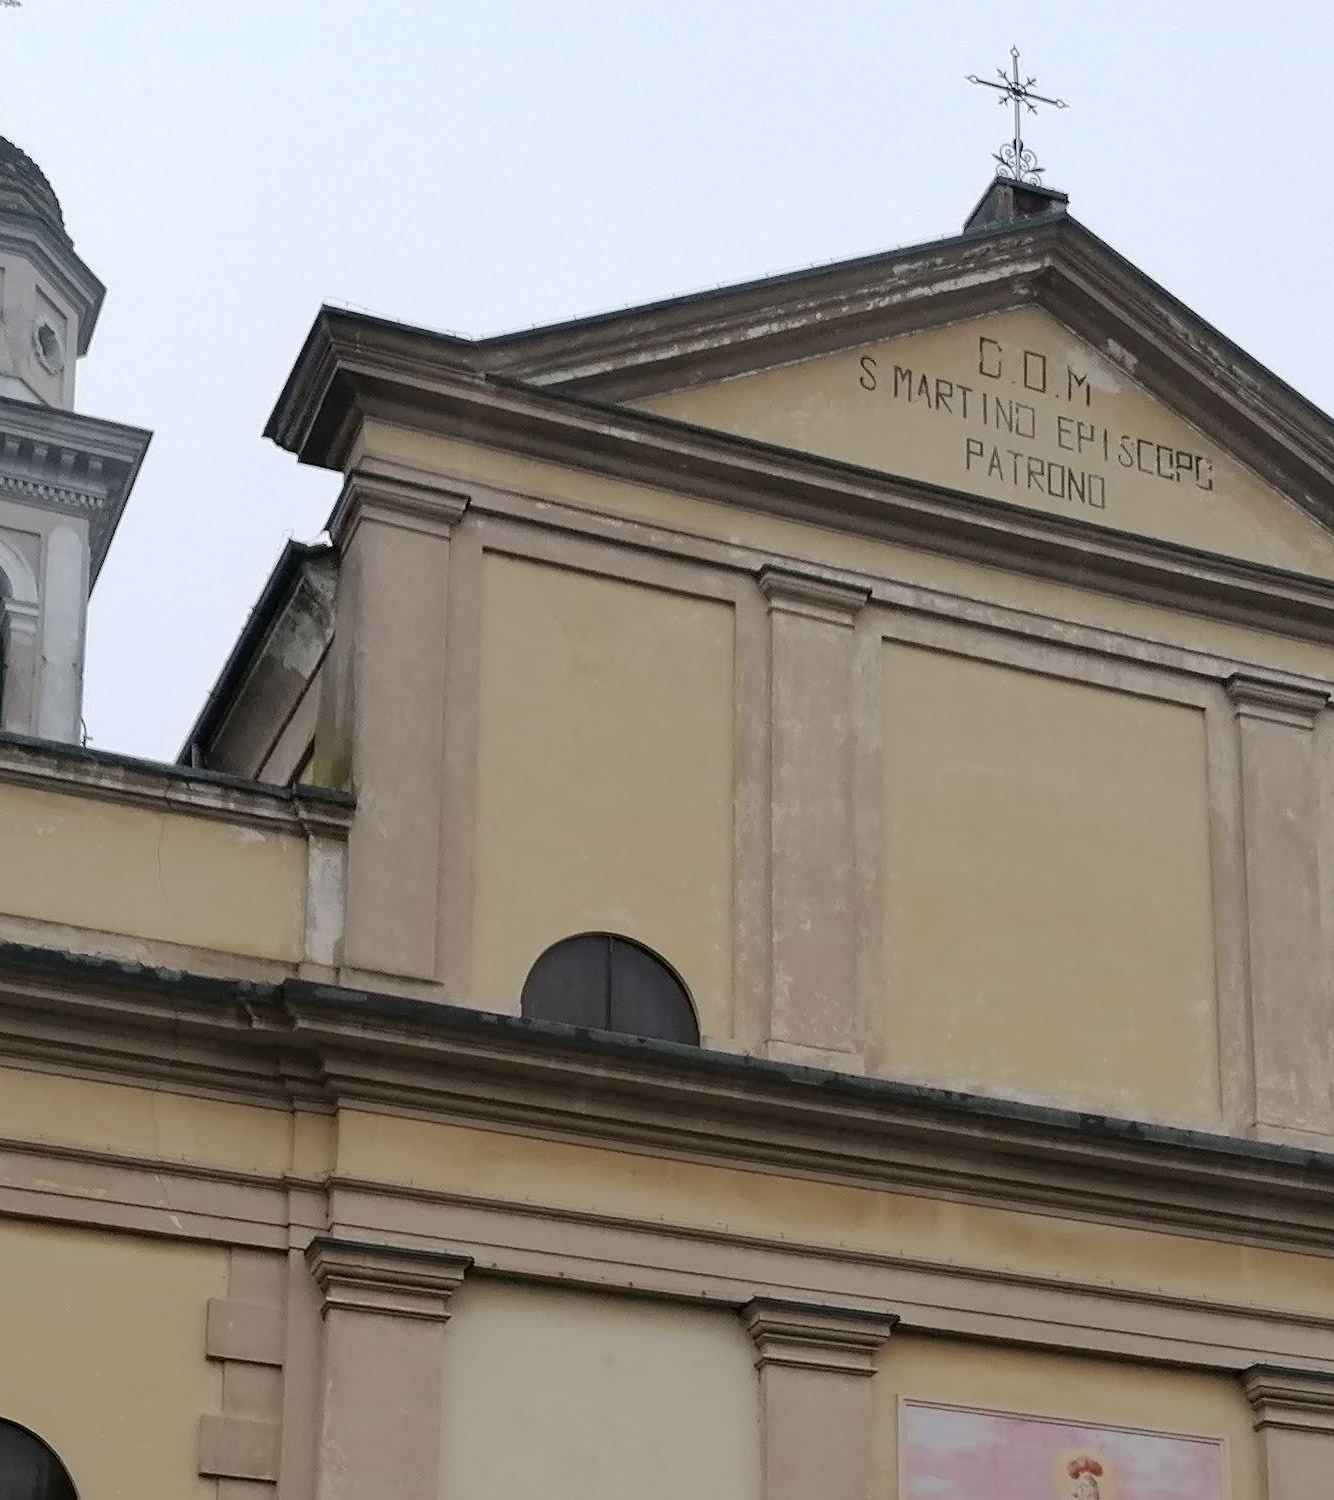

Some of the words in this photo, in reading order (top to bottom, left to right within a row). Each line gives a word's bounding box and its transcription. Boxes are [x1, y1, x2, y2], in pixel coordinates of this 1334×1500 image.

[859, 355, 877, 391] S
[893, 365, 1036, 439] MARTINO
[1056, 415, 1213, 491] EPISCOPO
[966, 437, 1106, 510] PATRONO
